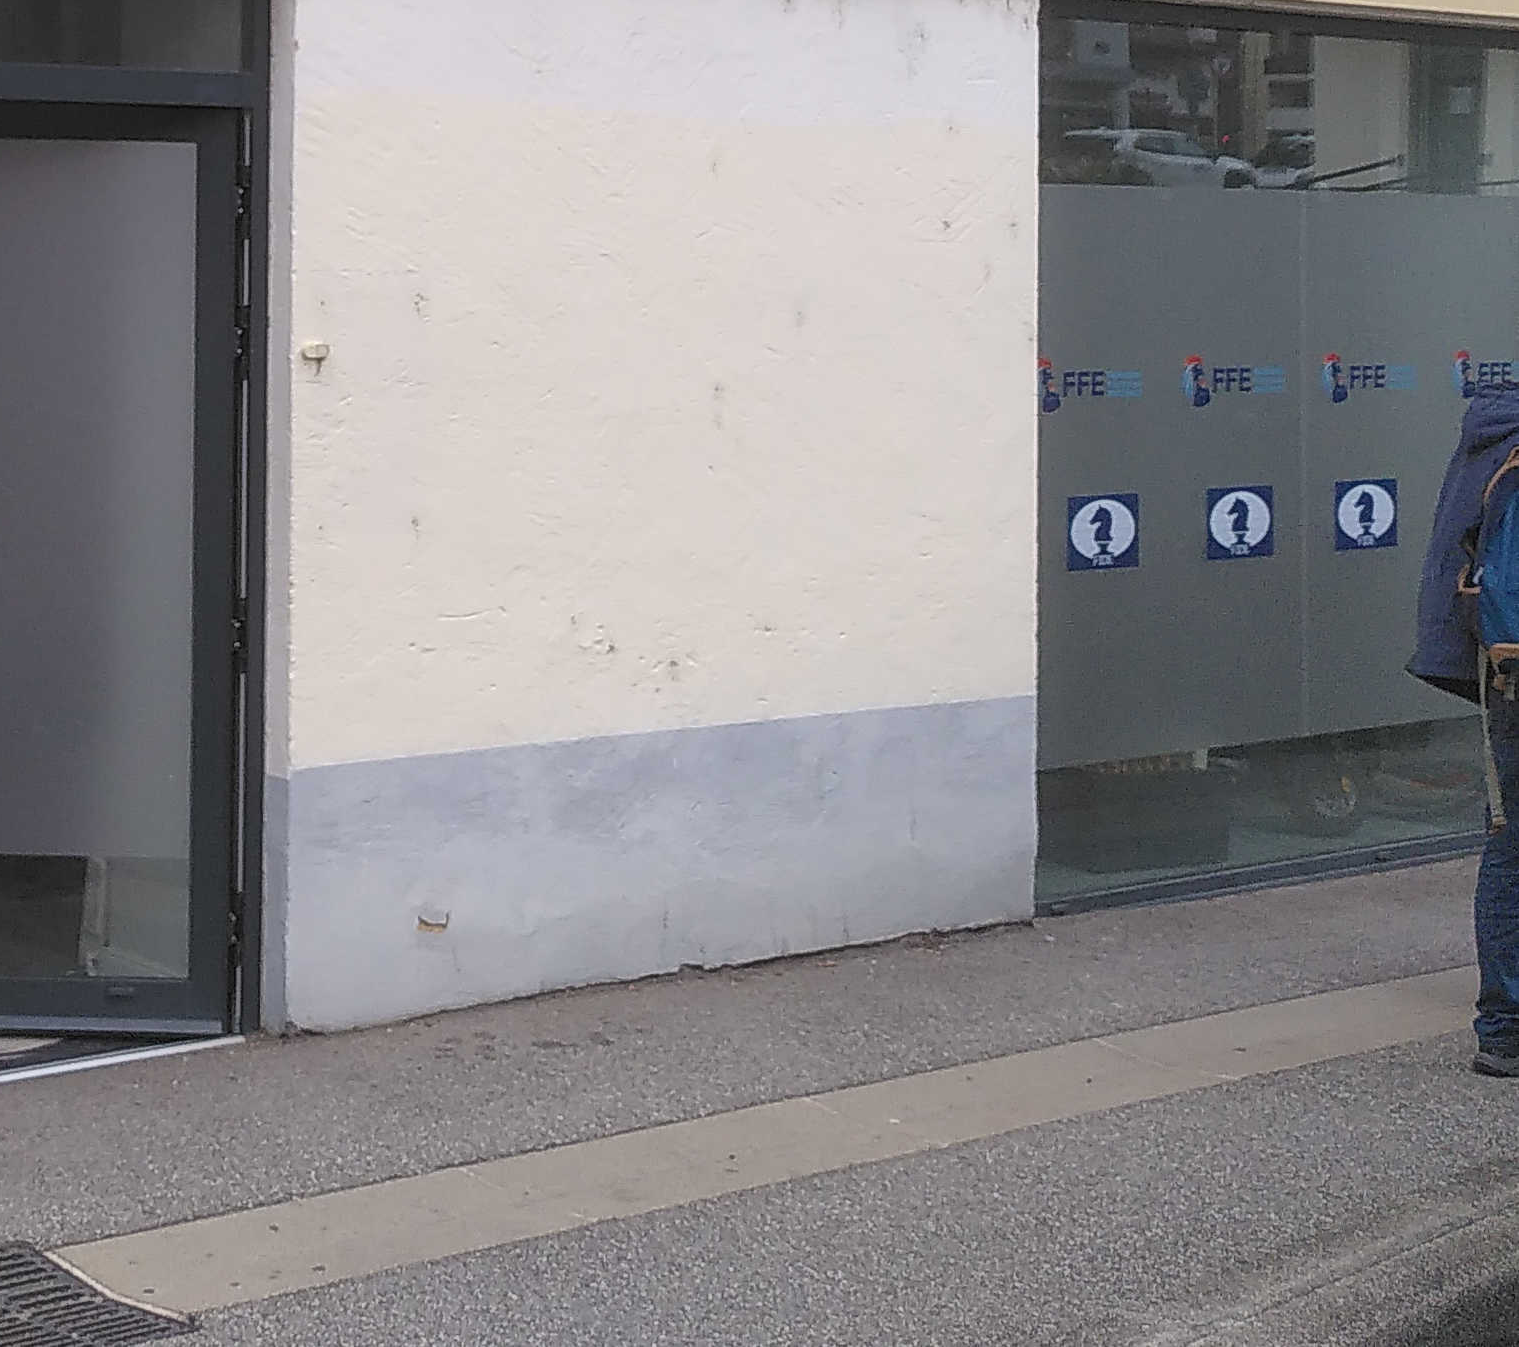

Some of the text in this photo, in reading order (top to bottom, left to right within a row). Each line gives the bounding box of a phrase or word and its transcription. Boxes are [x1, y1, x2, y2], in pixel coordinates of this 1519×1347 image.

[1062, 370, 1105, 398] FFE
[1213, 367, 1252, 394] FFE
[1349, 364, 1386, 390] FFE
